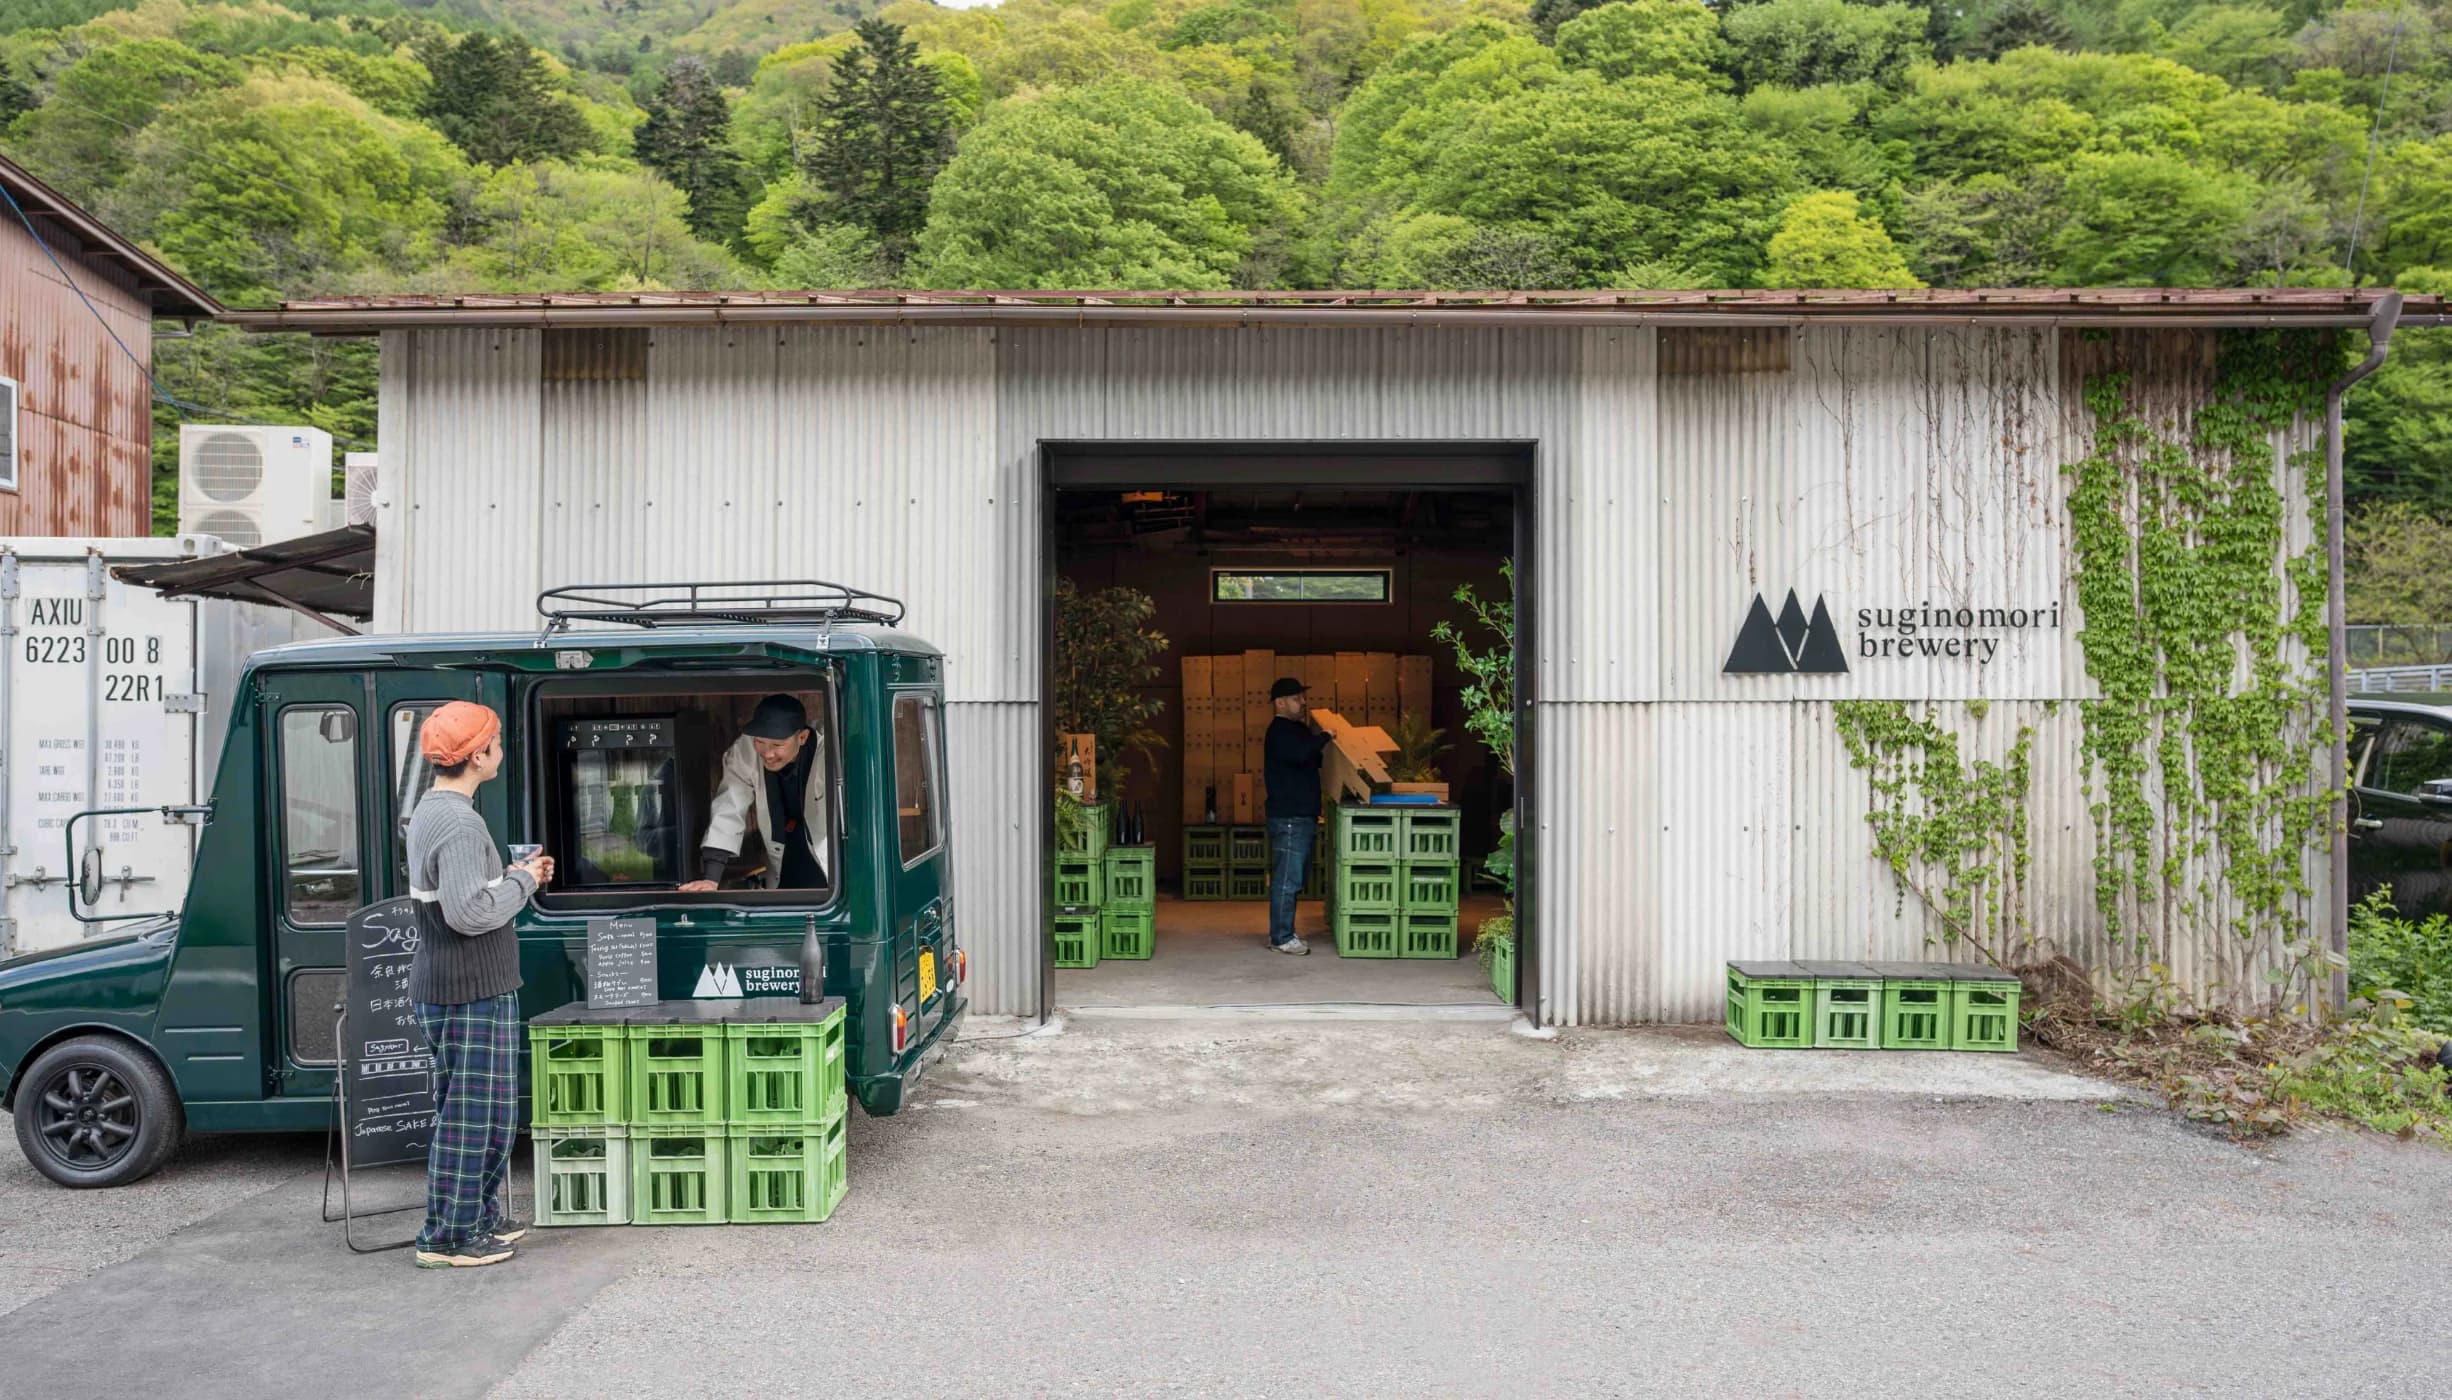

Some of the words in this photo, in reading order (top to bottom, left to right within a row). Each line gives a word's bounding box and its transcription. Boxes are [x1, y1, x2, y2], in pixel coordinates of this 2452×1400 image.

[31, 598, 83, 625] AXIU
[1857, 600, 2059, 635] suginomori
[25, 636, 86, 664] 6223
[106, 637, 135, 664] 00
[147, 637, 159, 664] 8
[1858, 631, 2000, 664] brewery
[105, 674, 163, 702] 22R1
[745, 979, 801, 994] brewery
[395, 1118, 428, 1133] SAKE
